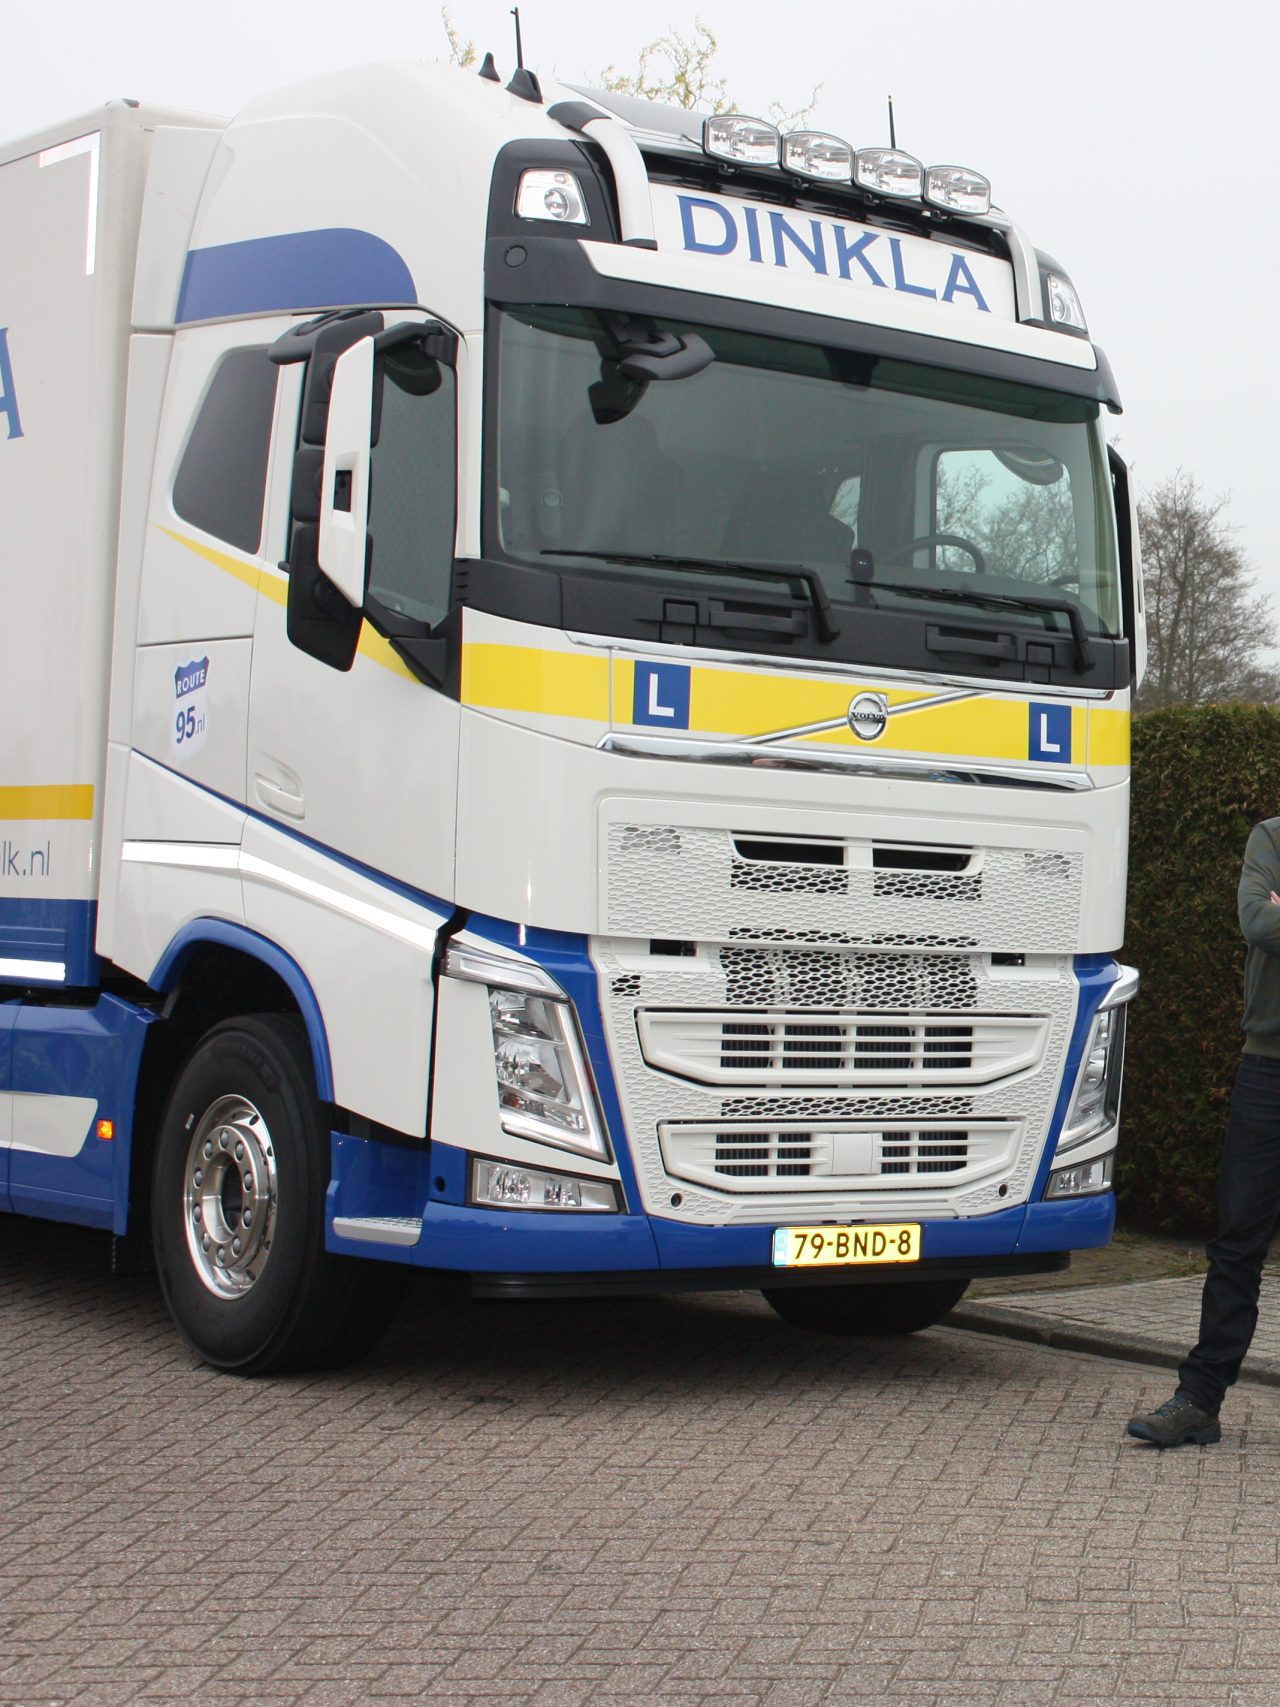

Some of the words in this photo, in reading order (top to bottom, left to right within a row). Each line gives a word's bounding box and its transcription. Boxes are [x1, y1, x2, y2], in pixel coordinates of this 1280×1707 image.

[676, 194, 991, 313] DINKLA
[177, 668, 206, 695] ROUTE
[648, 672, 675, 718] L
[851, 711, 885, 722] VOLVO
[1040, 712, 1061, 753] L
[794, 1229, 911, 1260] 79-BND-8
